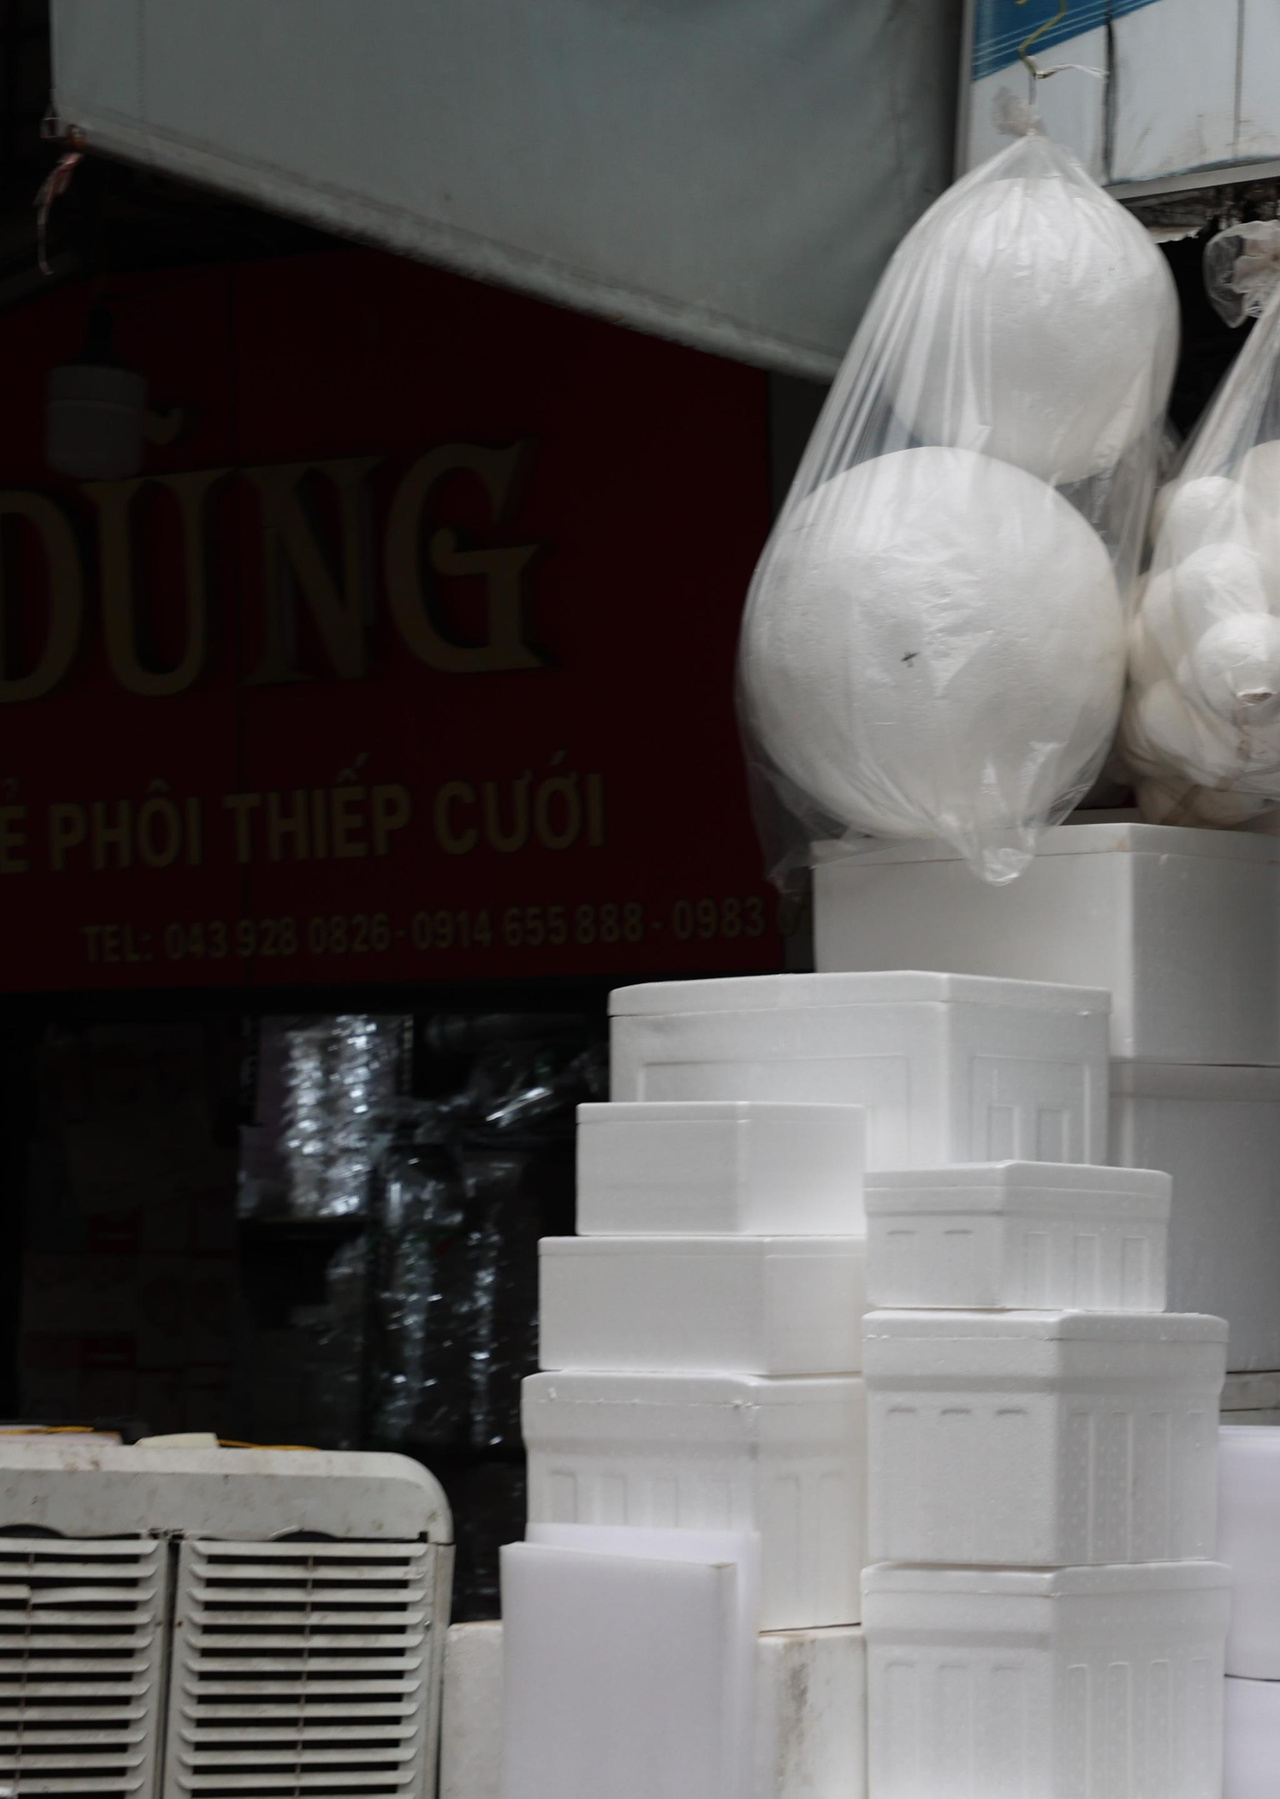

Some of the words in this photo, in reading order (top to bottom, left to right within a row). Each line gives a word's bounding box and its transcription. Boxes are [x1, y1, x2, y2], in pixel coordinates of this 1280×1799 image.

[48, 778, 203, 872] PHÔI
[221, 752, 412, 864] THIẾP
[432, 749, 606, 855] CƯỚI
[81, 924, 153, 964] TEL:
[503, 904, 568, 947] 655
[574, 900, 645, 945] 888
[671, 895, 766, 941] 0983
